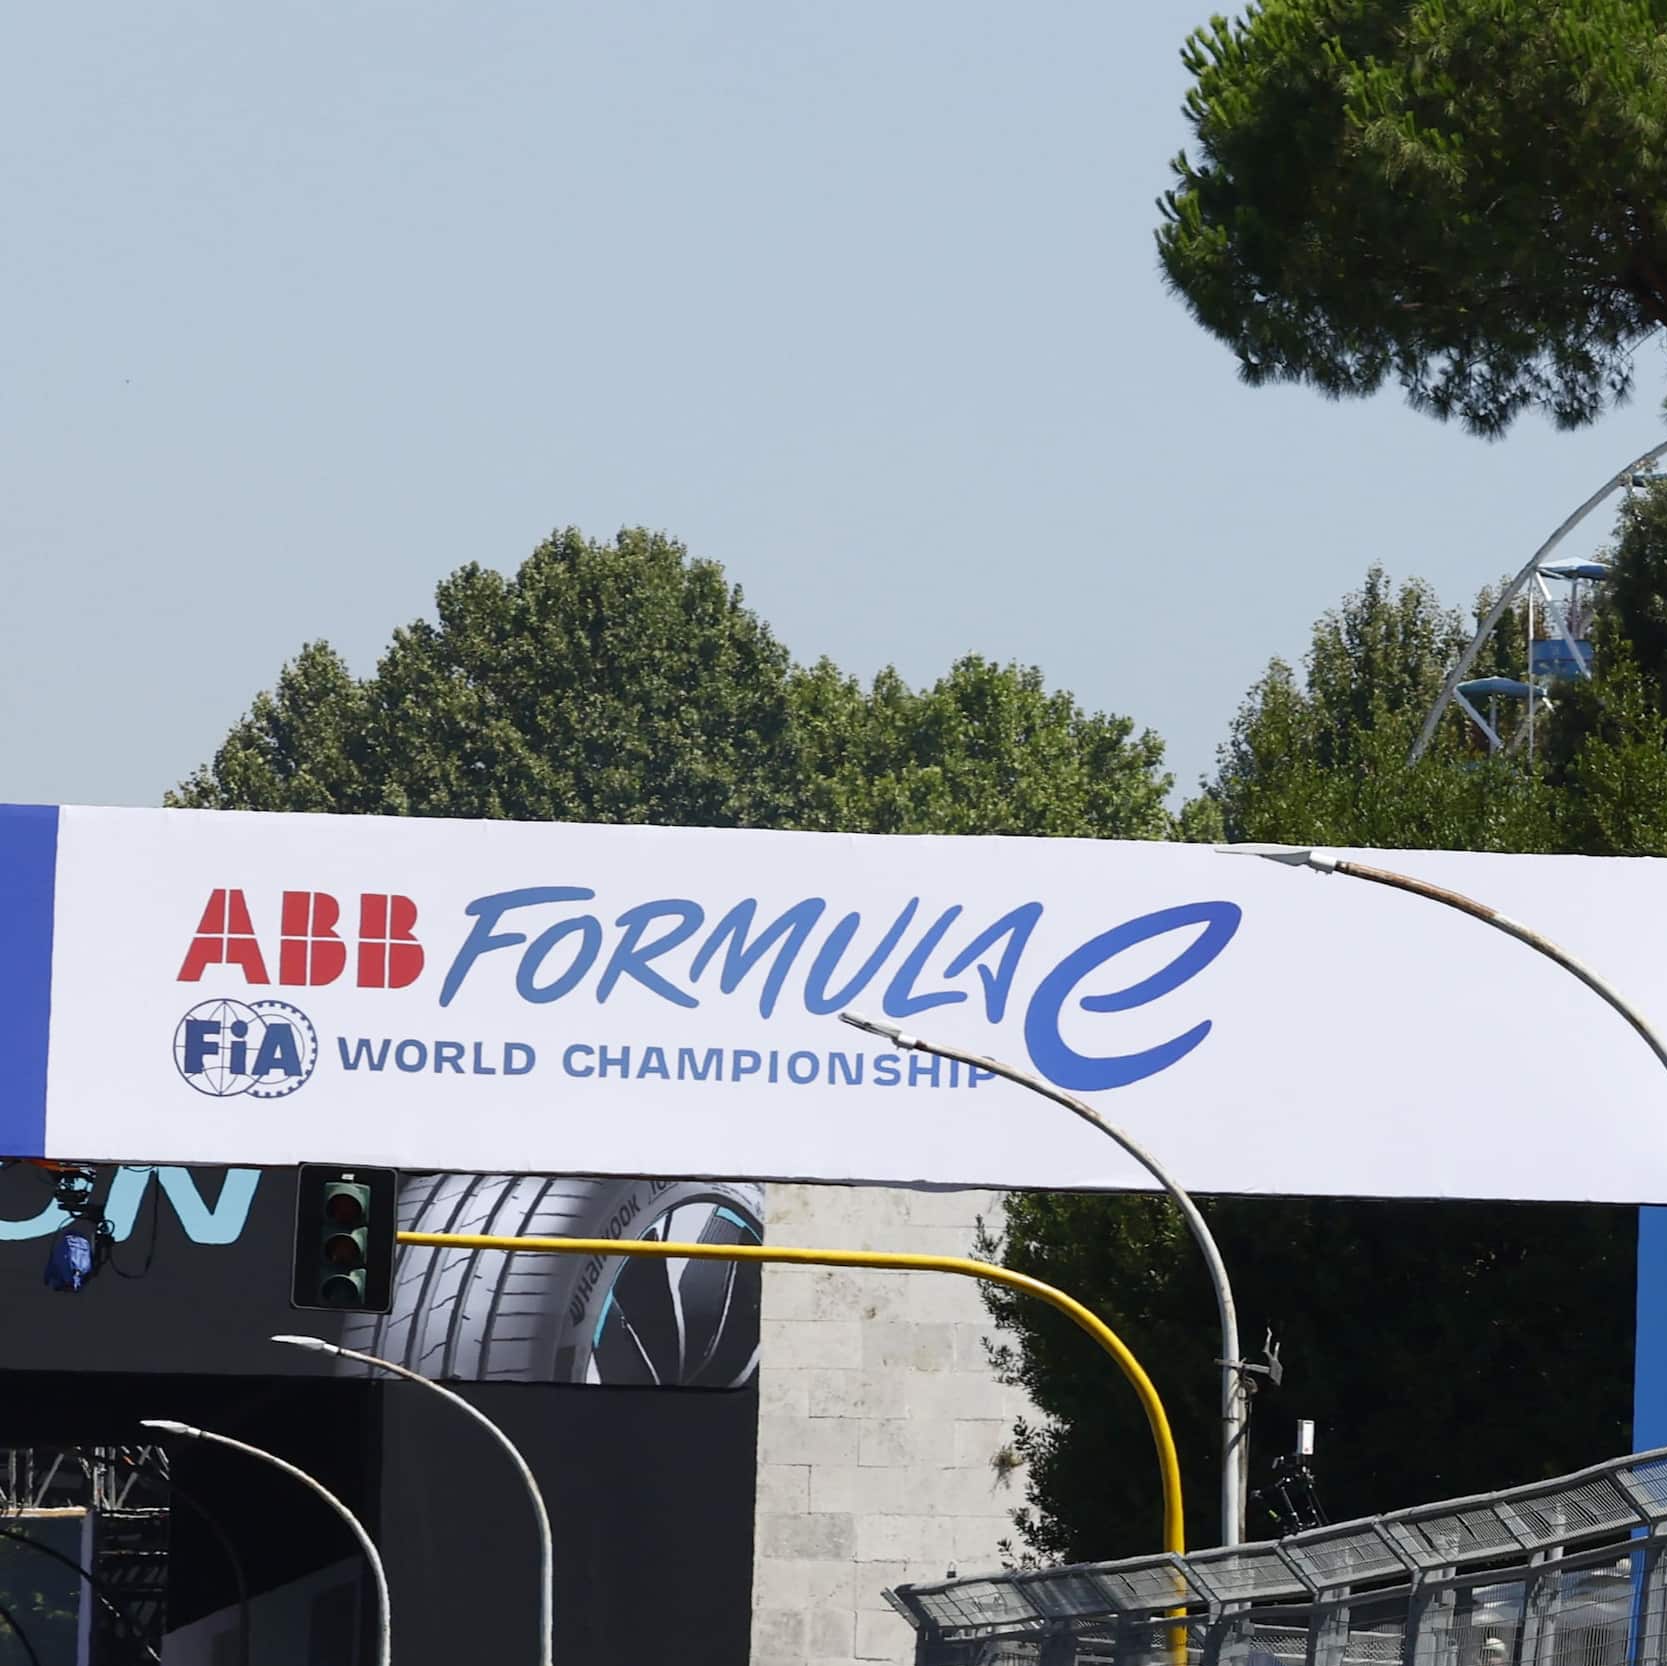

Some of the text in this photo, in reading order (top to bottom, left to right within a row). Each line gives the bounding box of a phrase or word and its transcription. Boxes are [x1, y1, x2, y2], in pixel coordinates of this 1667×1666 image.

[176, 888, 425, 989] ABB
[438, 886, 1044, 1025] FORMULA
[337, 1036, 998, 1089] WORLD CHAMPIONSHIP
